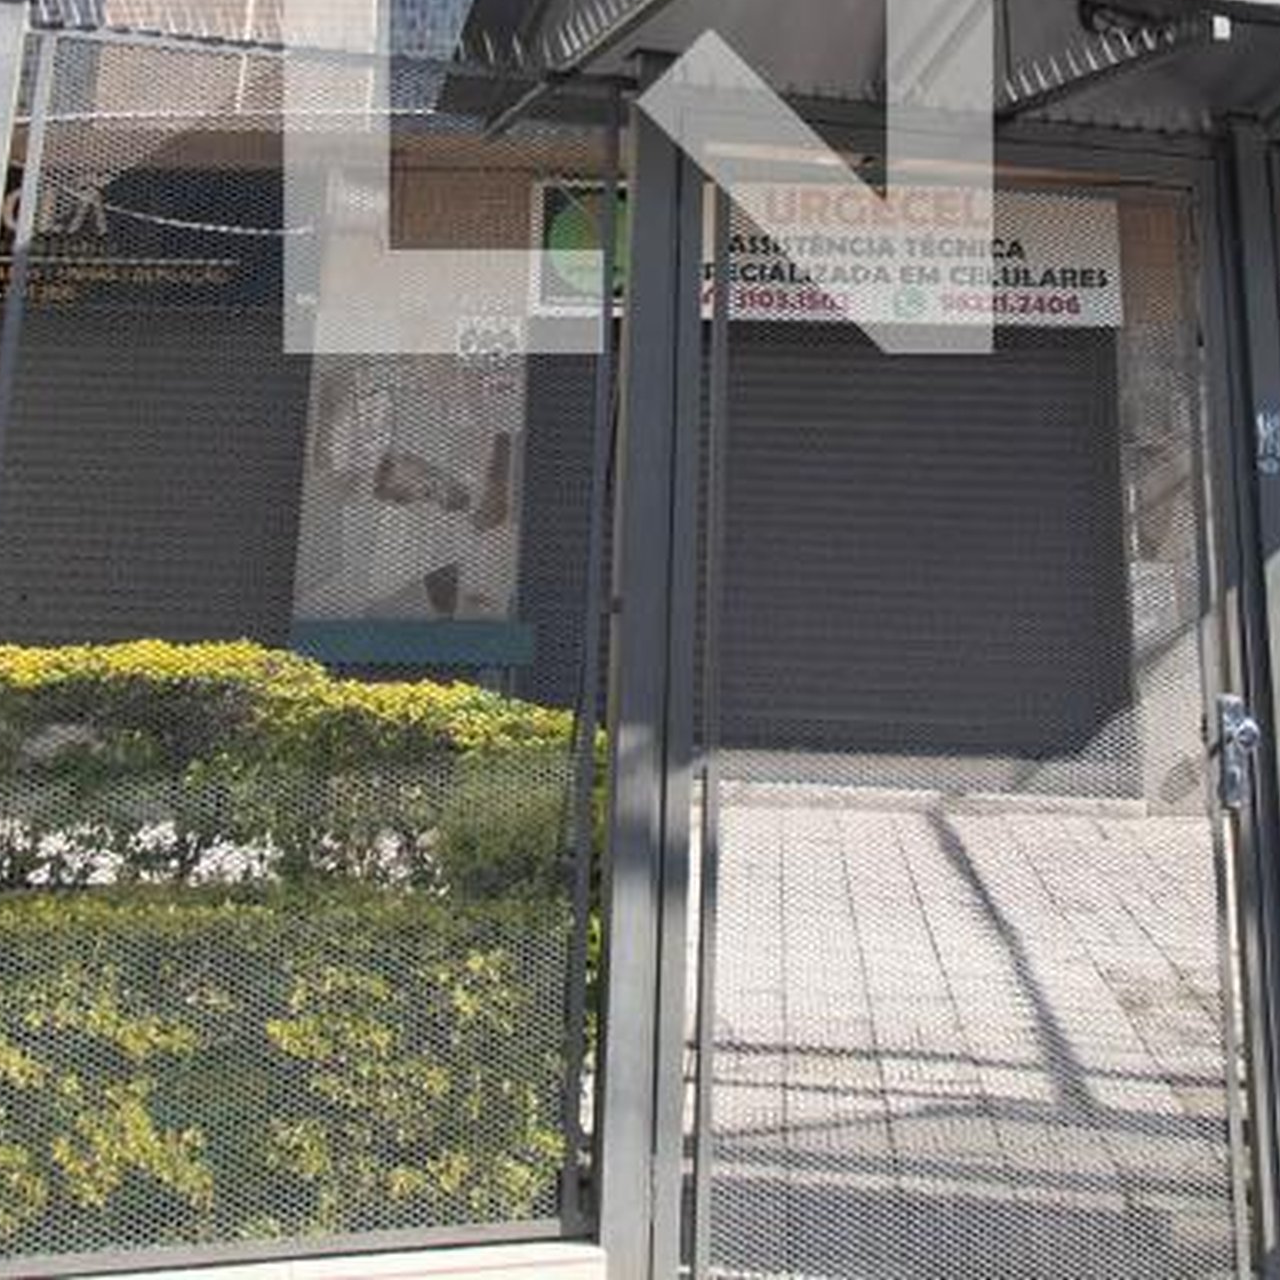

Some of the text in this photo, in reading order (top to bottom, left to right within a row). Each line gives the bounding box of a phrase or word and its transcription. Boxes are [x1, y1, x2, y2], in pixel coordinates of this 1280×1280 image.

[904, 234, 1025, 260] TÉCNICA
[900, 265, 941, 286] EM
[950, 265, 1109, 289] CELULARES
